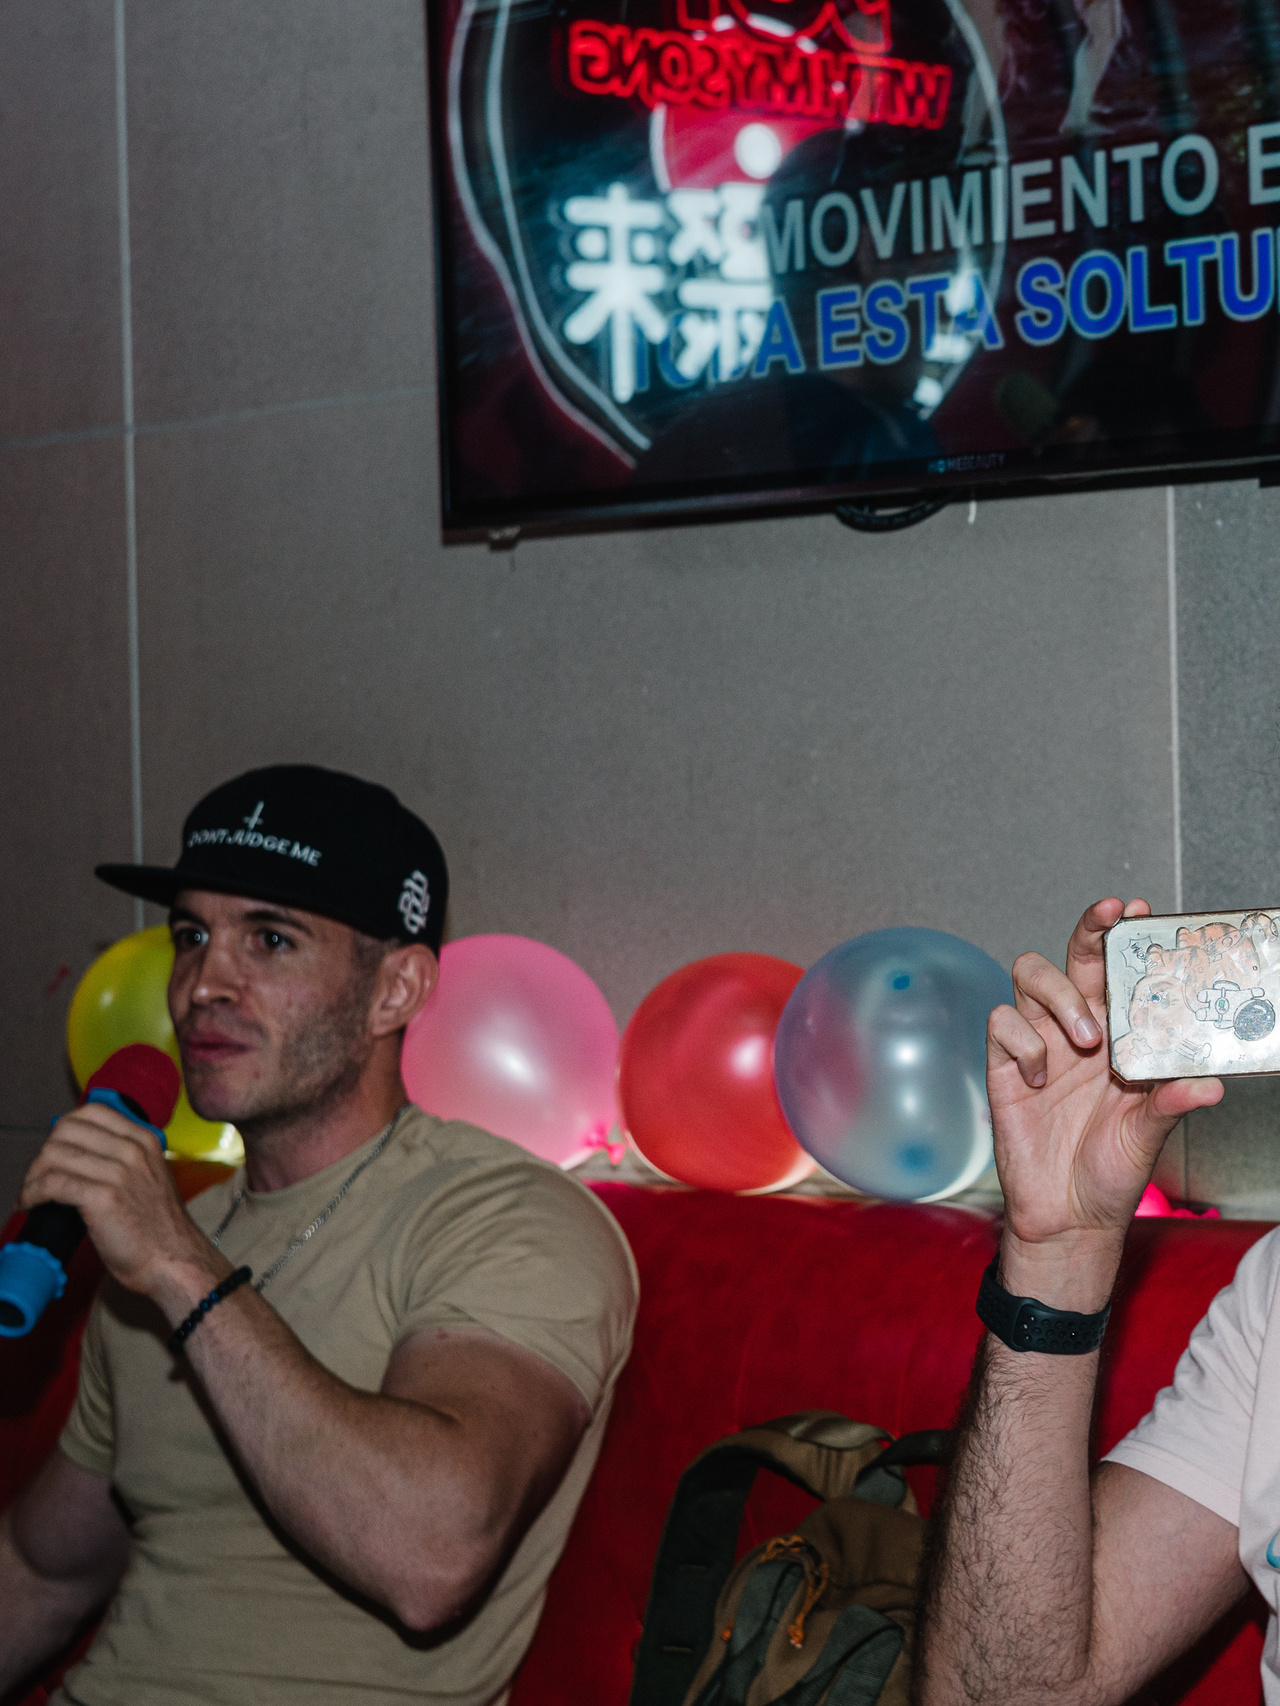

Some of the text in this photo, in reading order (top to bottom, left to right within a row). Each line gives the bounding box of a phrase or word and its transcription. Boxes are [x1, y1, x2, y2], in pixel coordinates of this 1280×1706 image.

[760, 133, 1221, 275] MOVIMIENTO
[816, 271, 1005, 370] ESTA
[228, 829, 290, 855] JUDGE
[290, 840, 322, 867] ME
